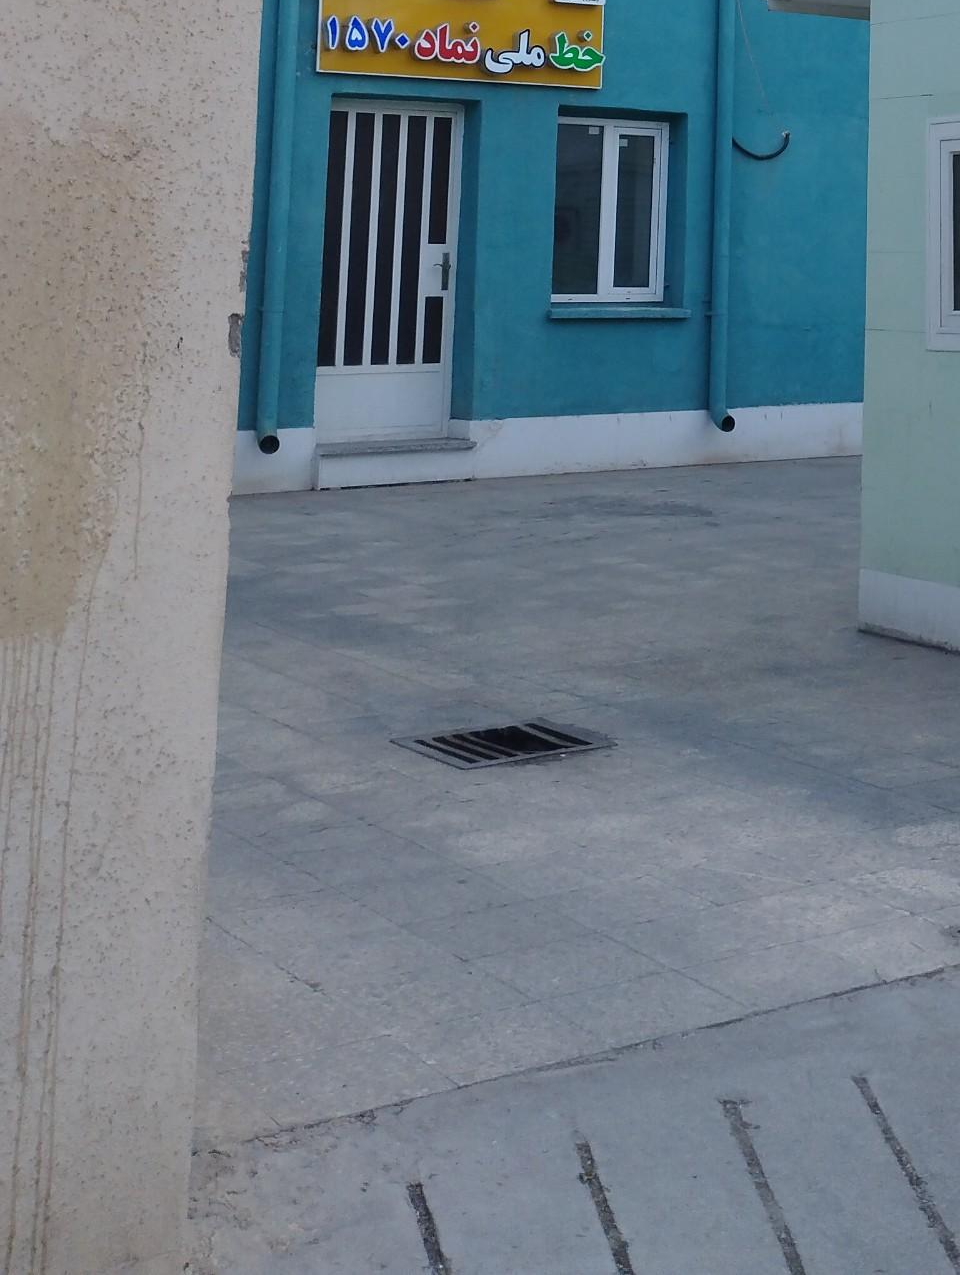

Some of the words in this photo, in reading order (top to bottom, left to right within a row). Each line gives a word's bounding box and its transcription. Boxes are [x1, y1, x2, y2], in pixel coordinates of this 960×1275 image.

[325, 14, 411, 53] ۱۵۷۰
[413, 21, 481, 65] نماد
[484, 28, 545, 74] ملی
[550, 30, 606, 72] خط
